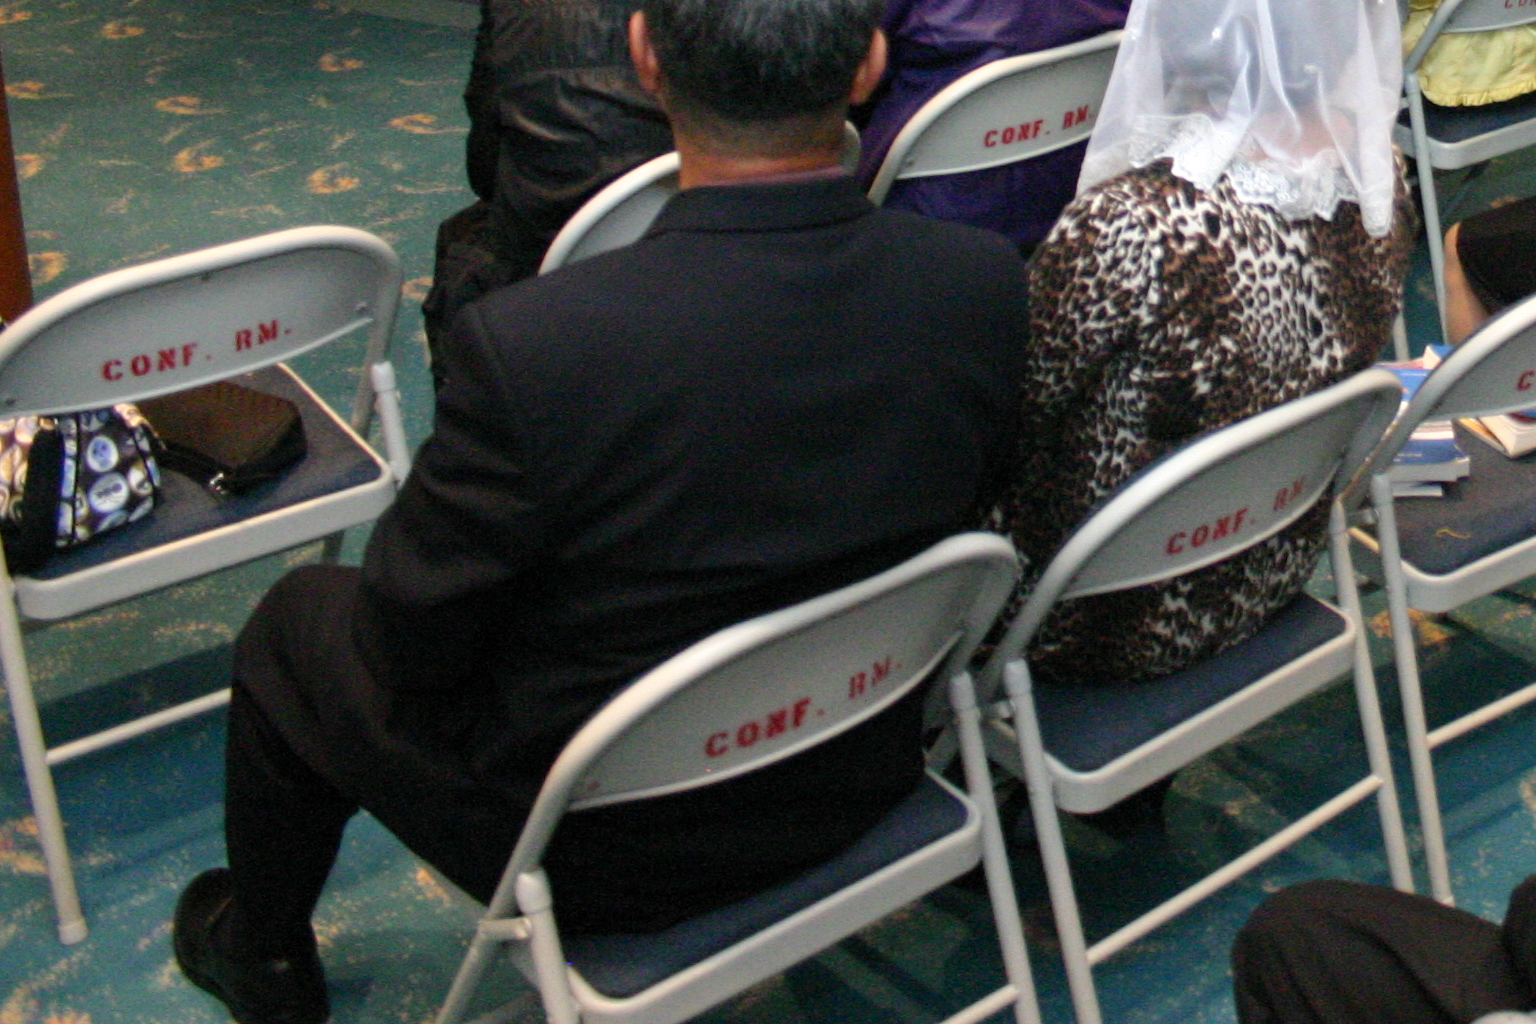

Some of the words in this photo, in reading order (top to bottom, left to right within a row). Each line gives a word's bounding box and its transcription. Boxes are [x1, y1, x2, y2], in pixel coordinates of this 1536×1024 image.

[984, 119, 1051, 147] CONF.
[102, 342, 212, 382] CONF.
[235, 319, 292, 352] RM.
[1166, 507, 1256, 555] CONF.
[705, 697, 825, 758] CONF.
